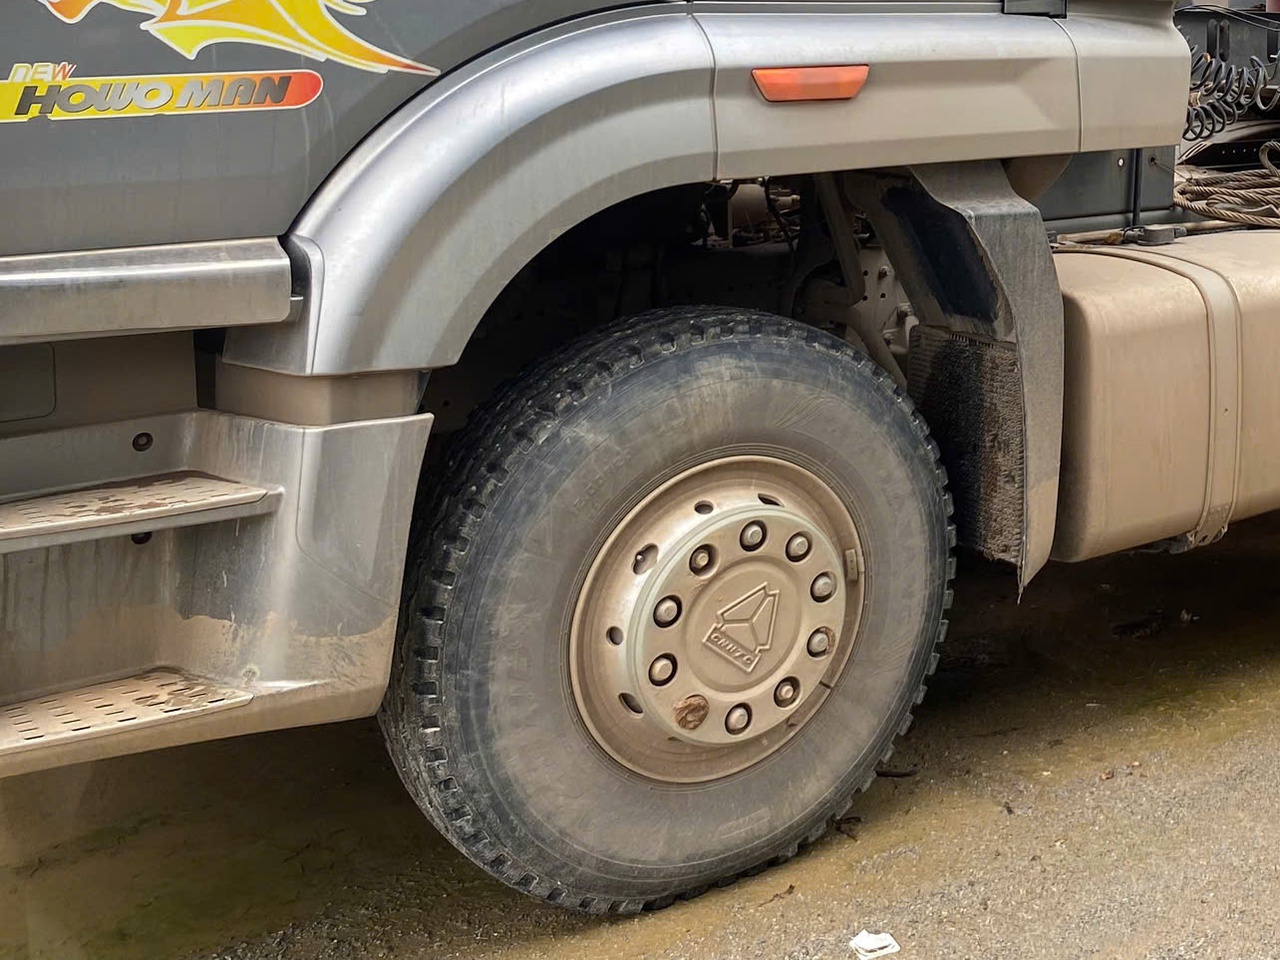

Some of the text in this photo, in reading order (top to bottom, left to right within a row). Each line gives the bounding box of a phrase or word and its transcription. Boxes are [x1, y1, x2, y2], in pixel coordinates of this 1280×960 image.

[14, 75, 292, 116] HOWO MAN
[710, 633, 754, 664] CNHTC
